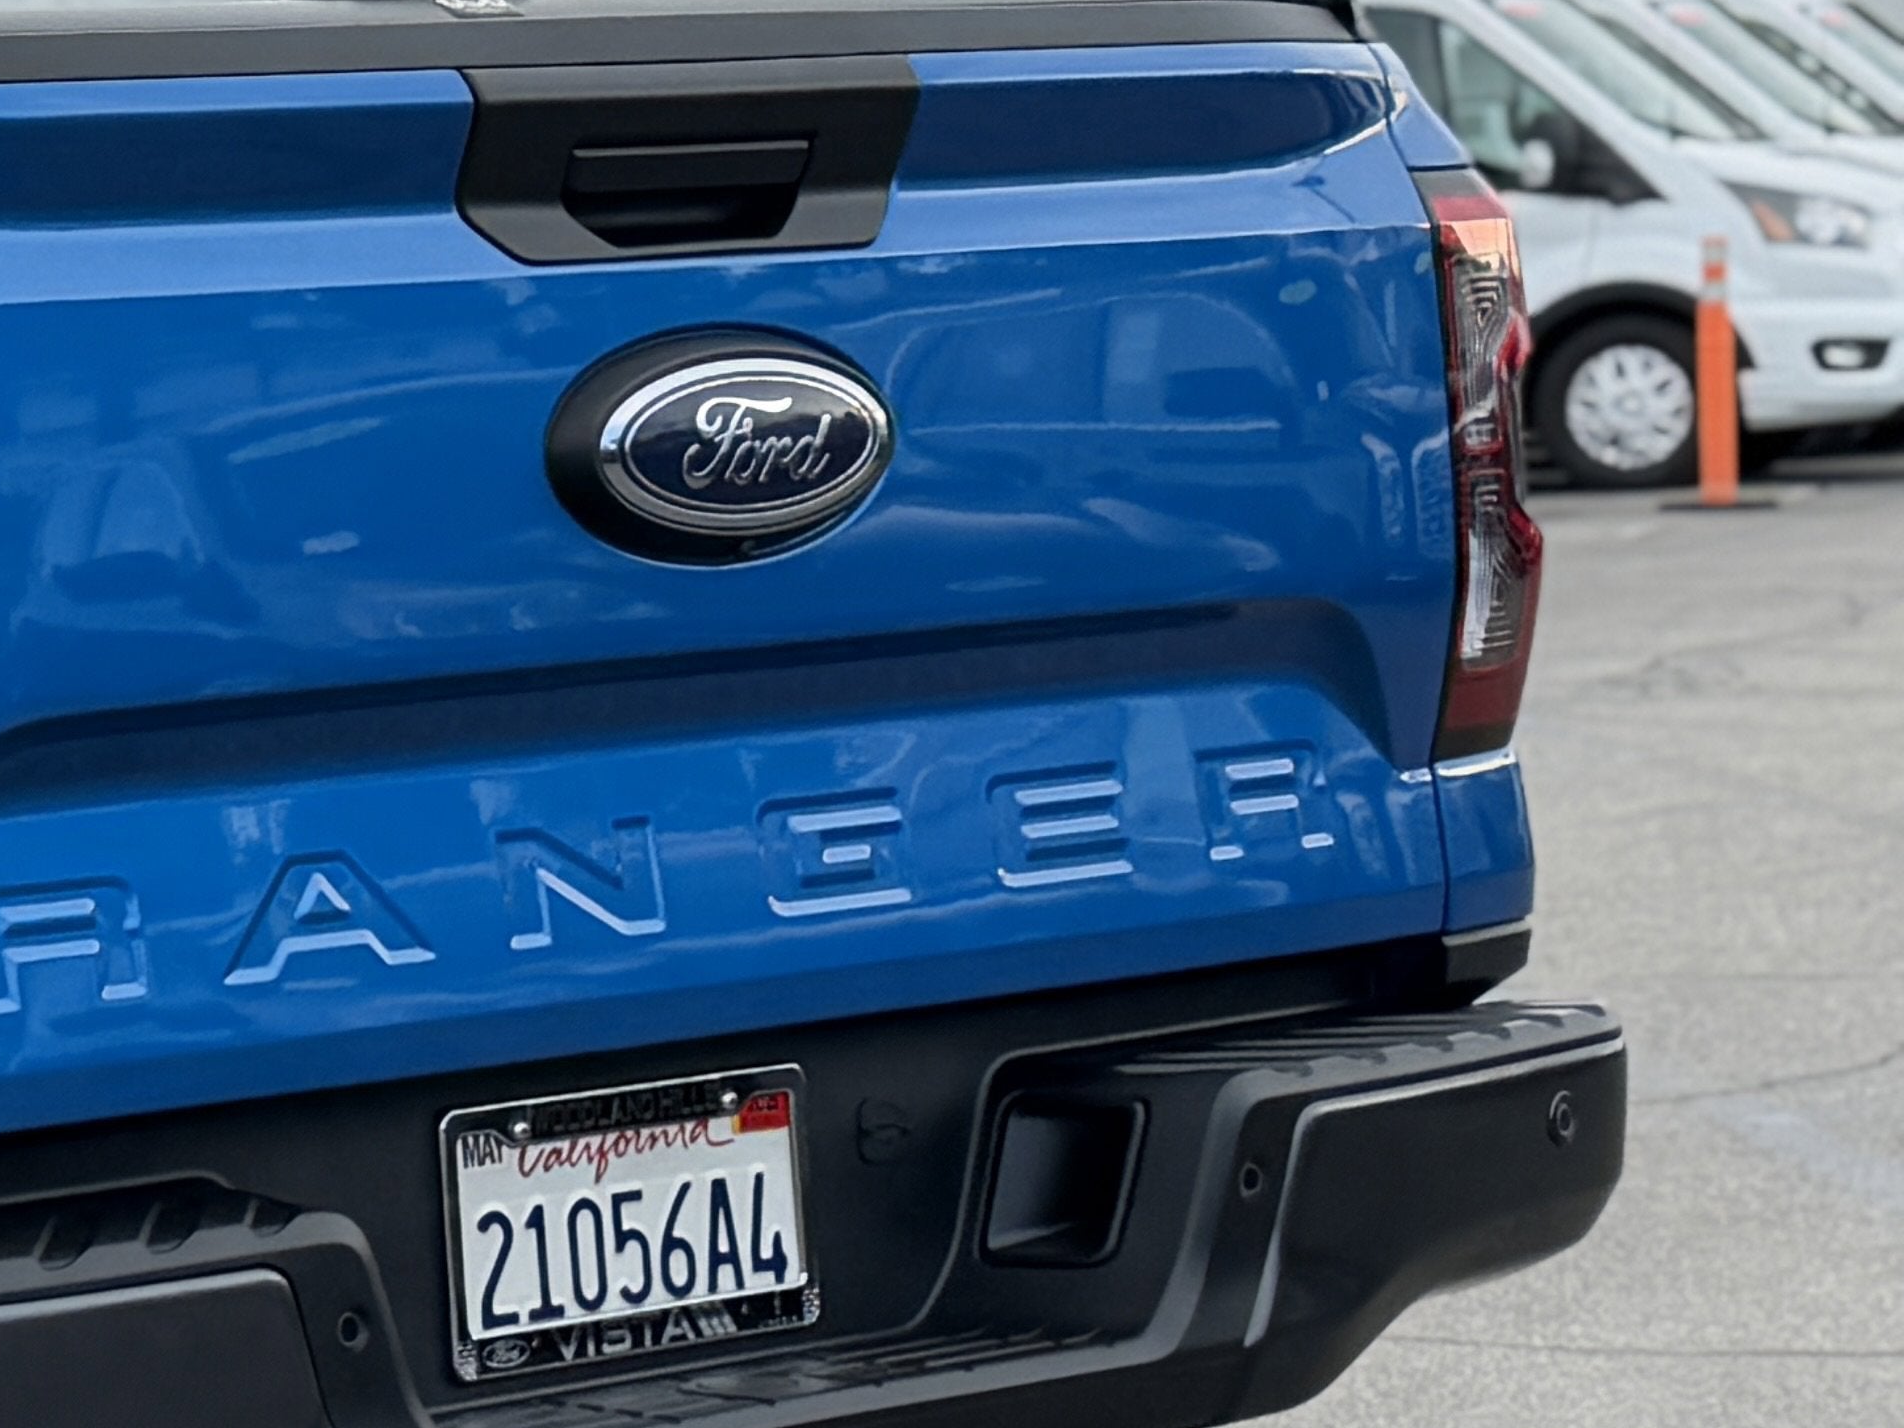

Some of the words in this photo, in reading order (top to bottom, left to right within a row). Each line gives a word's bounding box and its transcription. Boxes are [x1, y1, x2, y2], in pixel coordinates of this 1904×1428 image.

[682, 396, 832, 489] Ford
[462, 1133, 504, 1169] MAY
[518, 1118, 734, 1185] California
[477, 1171, 788, 1330] 21056A4
[552, 1305, 693, 1362] VISTA
